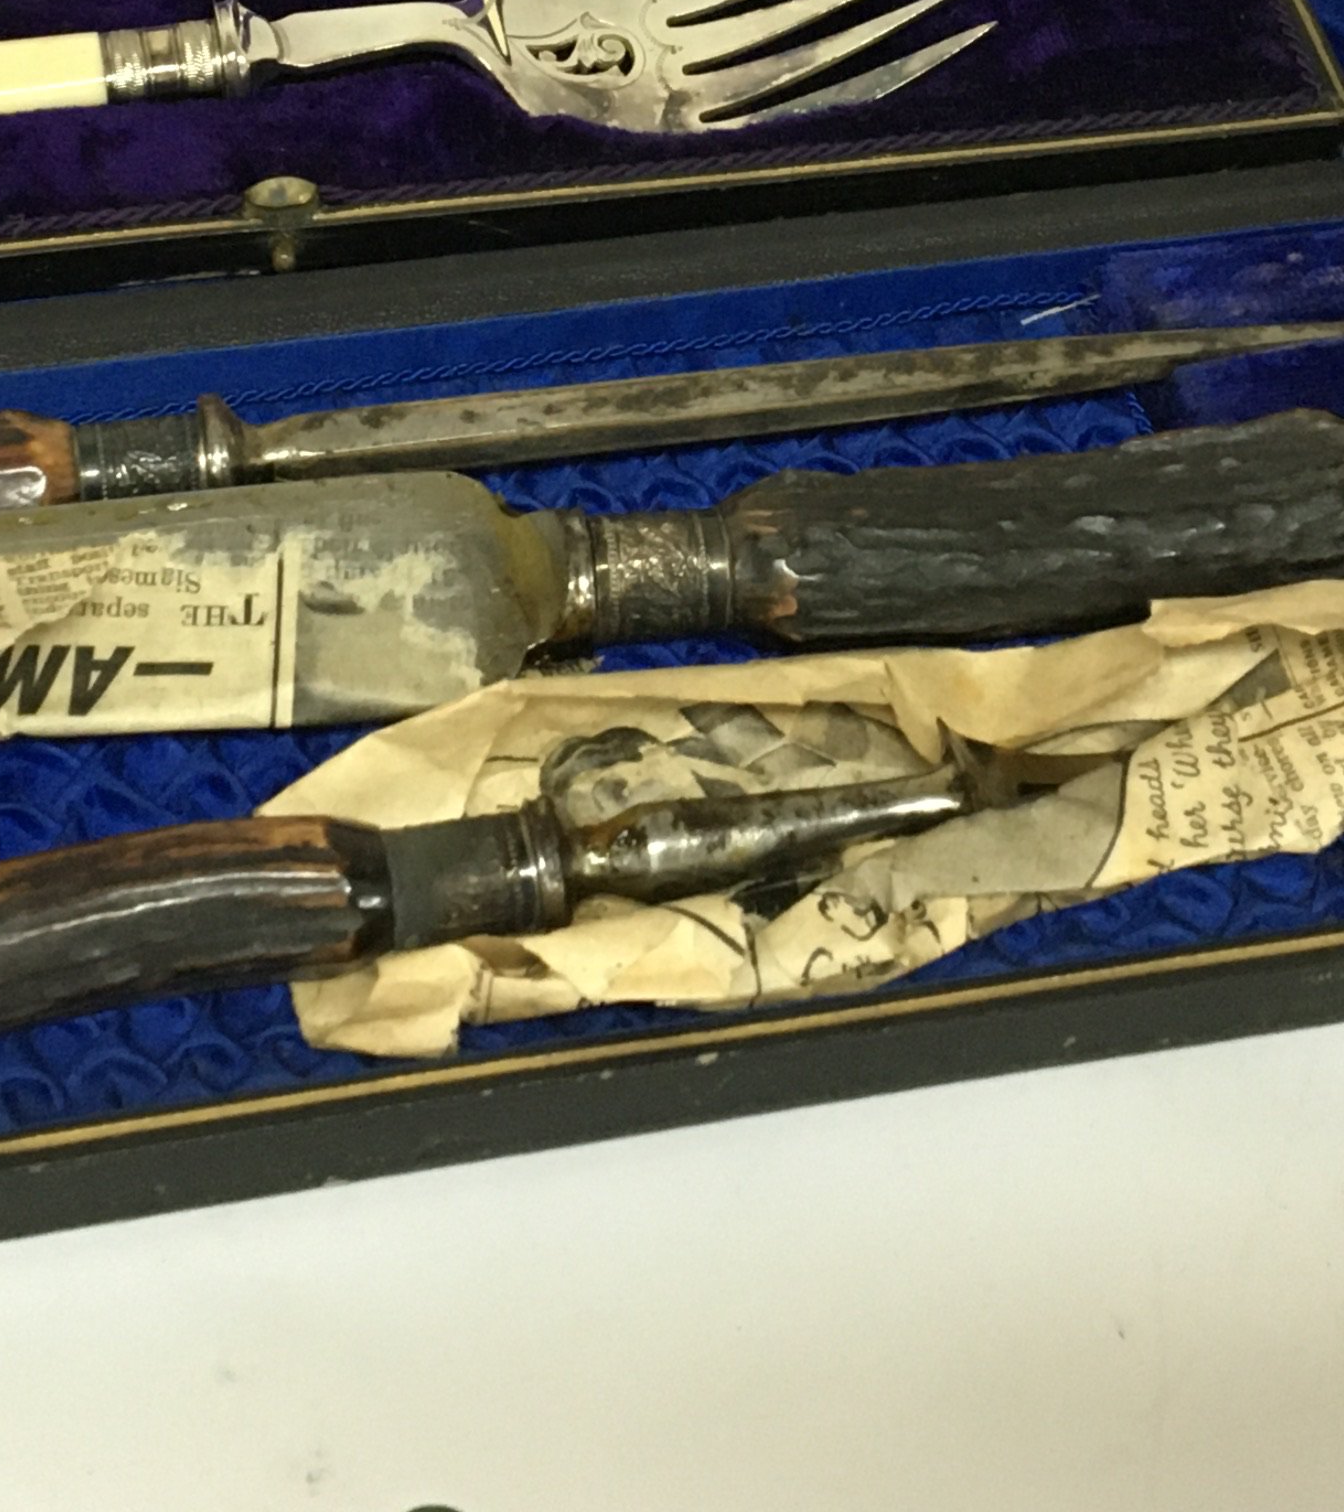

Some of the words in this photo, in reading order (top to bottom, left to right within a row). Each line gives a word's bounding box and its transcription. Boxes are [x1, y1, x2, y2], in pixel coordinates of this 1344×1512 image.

[180, 593, 270, 627] THE
[1137, 757, 1170, 840] heads
[1179, 800, 1209, 848] her
